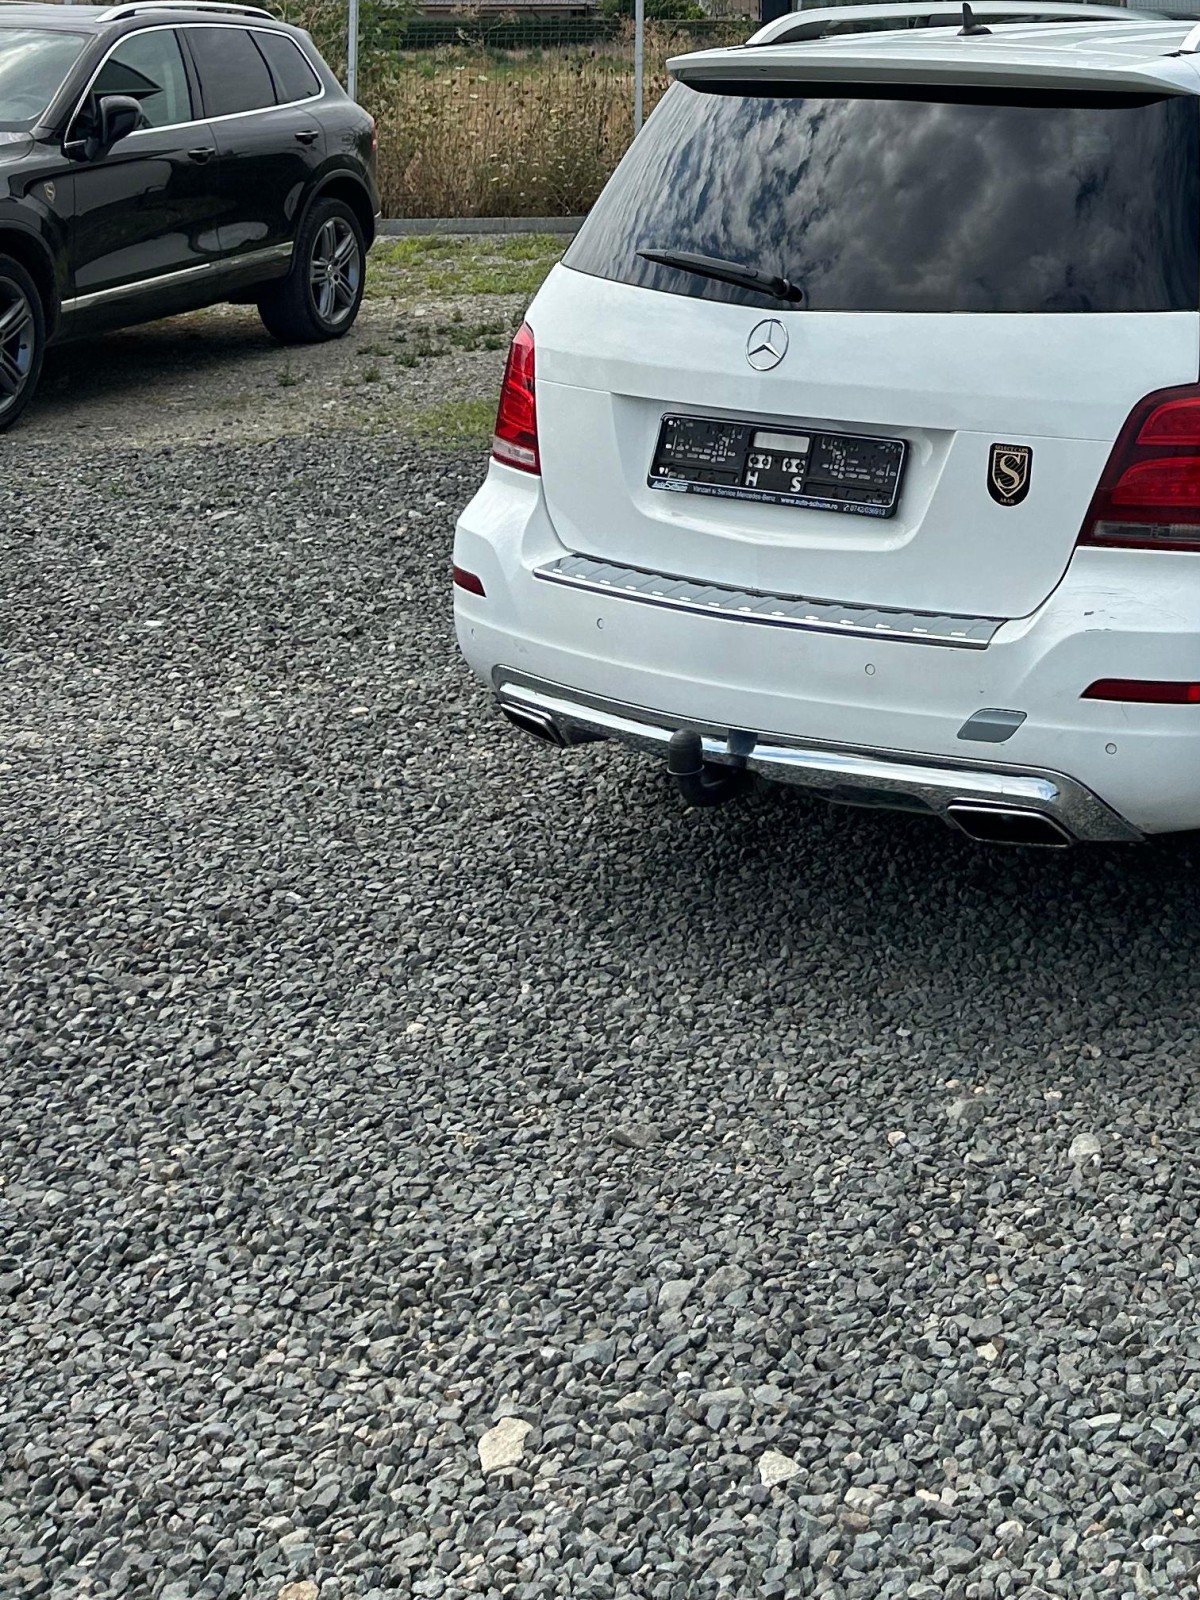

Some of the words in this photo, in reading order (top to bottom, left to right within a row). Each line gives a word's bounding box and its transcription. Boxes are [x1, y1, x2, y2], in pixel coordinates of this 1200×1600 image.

[745, 471, 758, 487] H
[997, 454, 1020, 489] S
[790, 477, 802, 493] S
